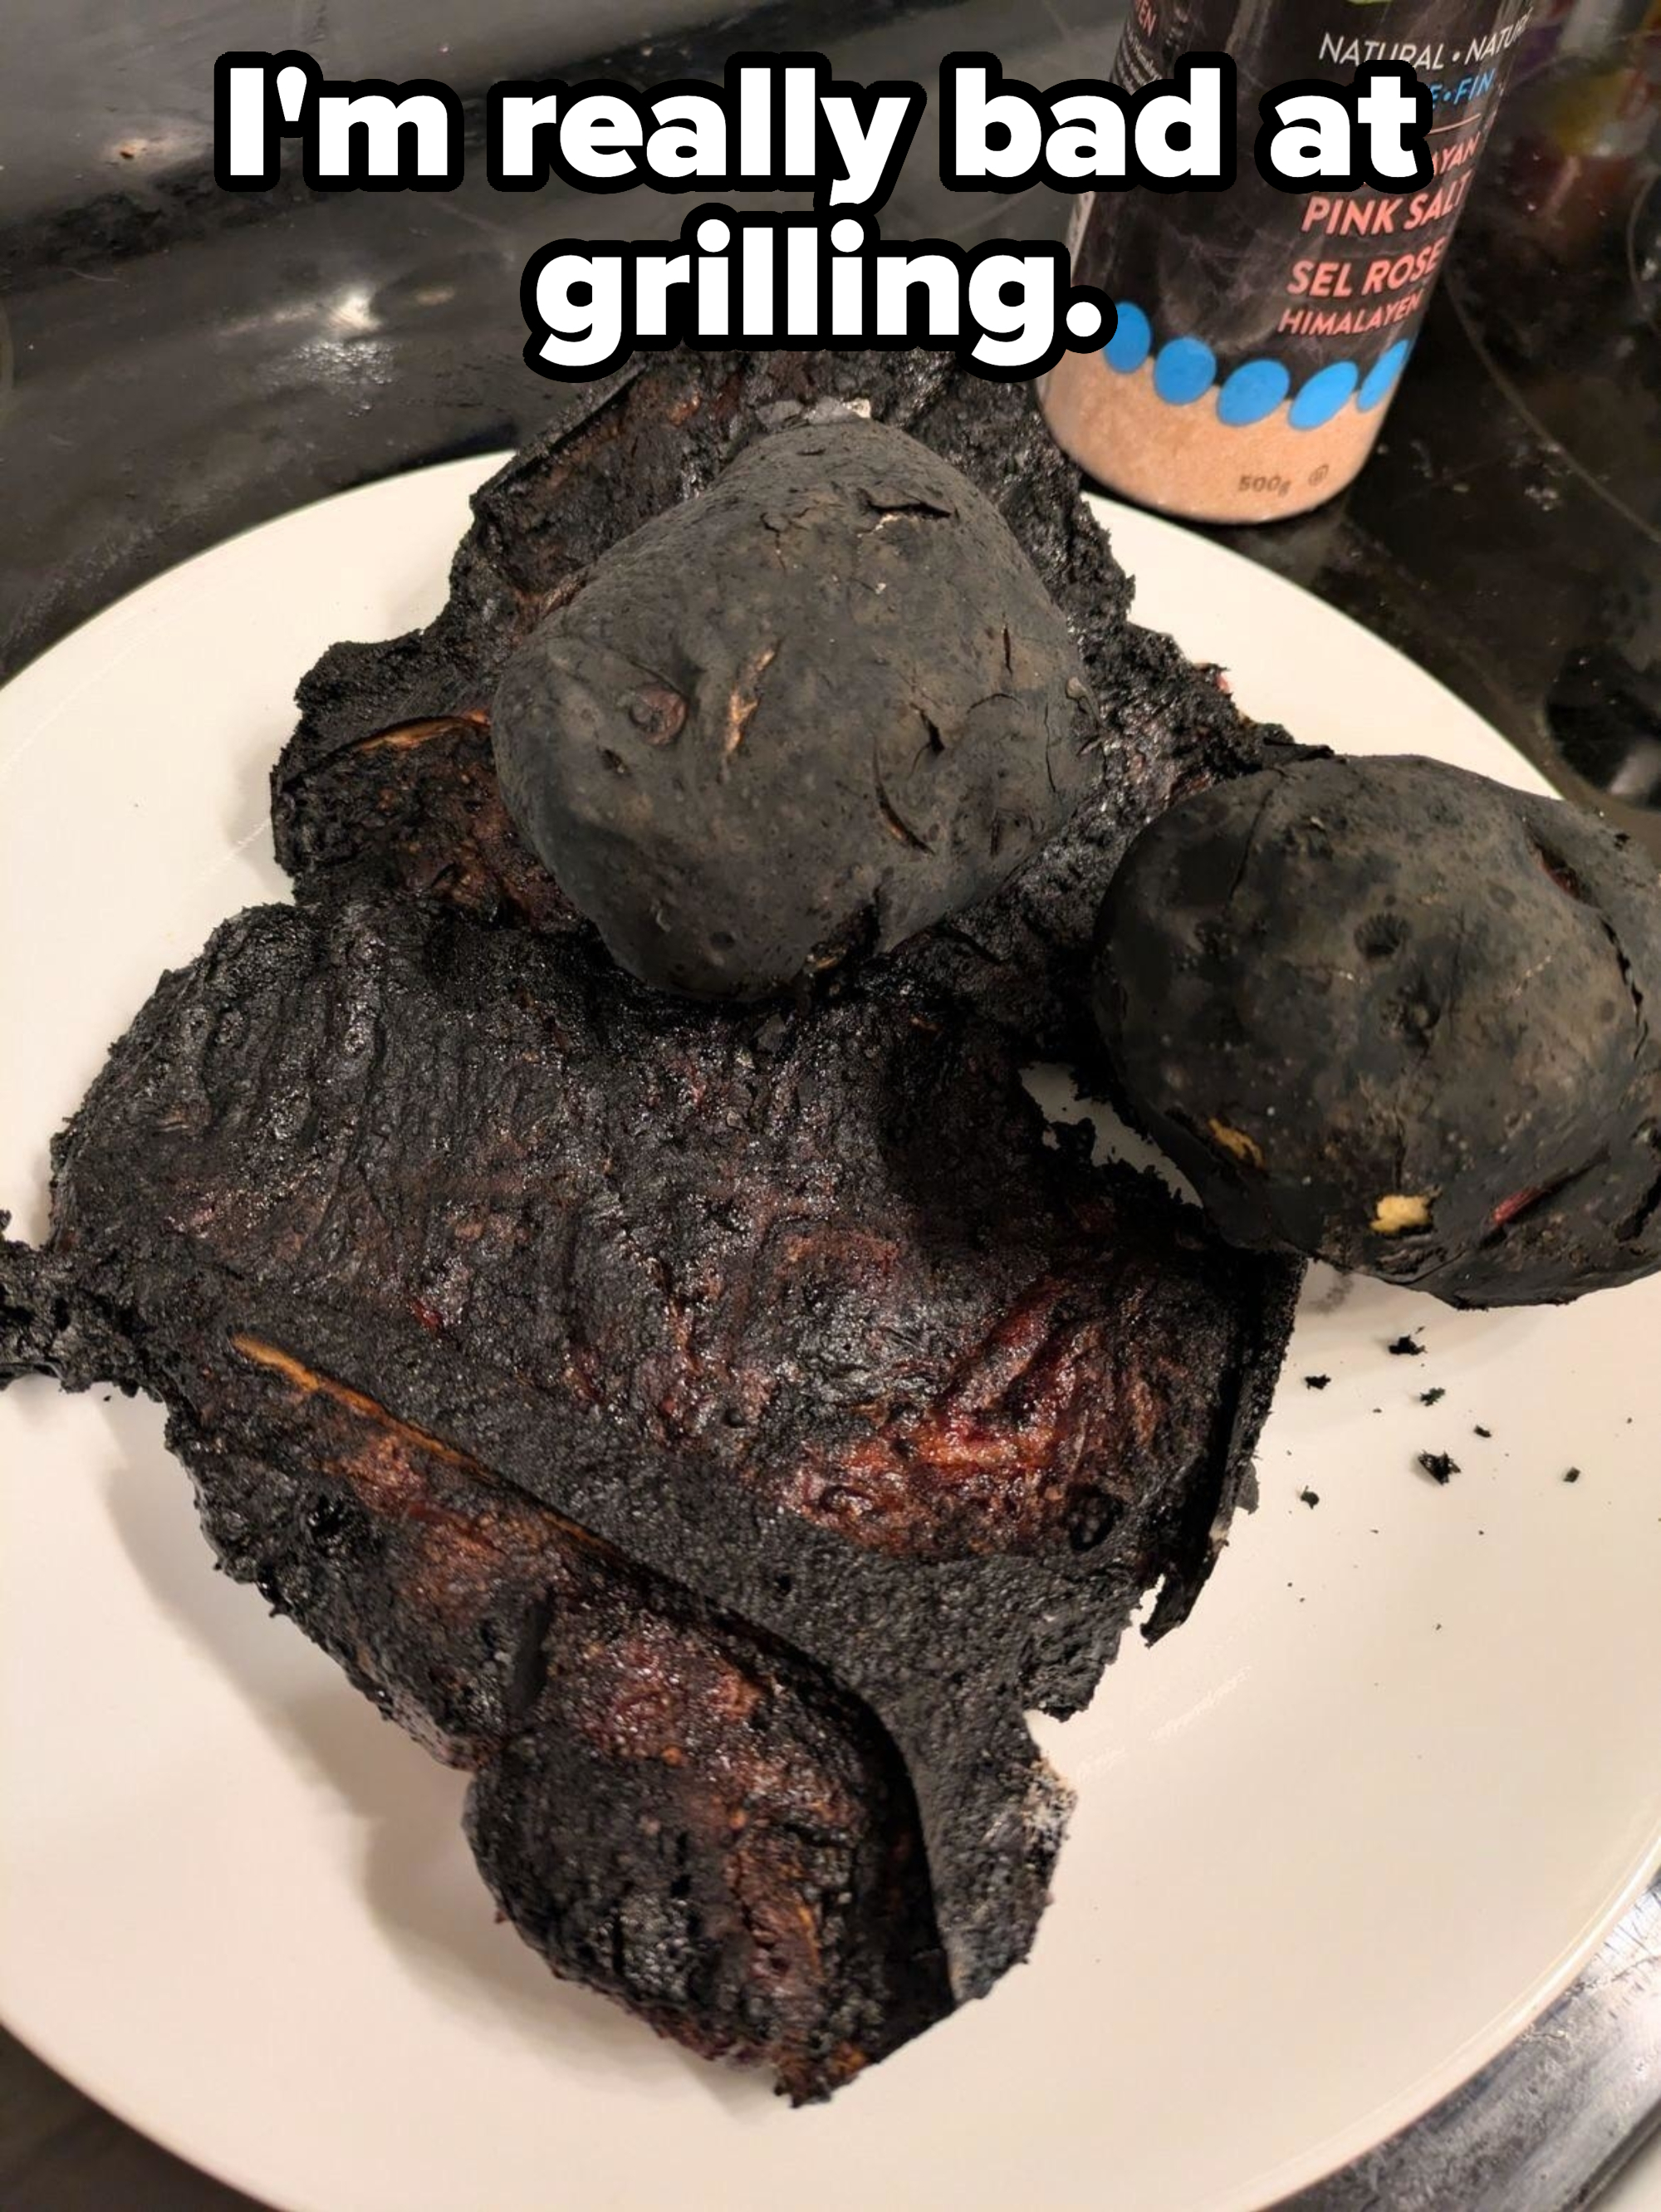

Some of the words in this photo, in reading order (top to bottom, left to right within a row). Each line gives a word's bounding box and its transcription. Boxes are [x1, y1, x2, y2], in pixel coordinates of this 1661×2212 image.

[1319, 32, 1444, 71] NATURAL
[1301, 196, 1404, 236] PINK
[1403, 169, 1475, 231] SALT
[1287, 259, 1353, 297] SEL
[1361, 237, 1446, 297] ROSE
[1277, 287, 1425, 336] HIMALAYEN
[1238, 475, 1292, 498] 500g
